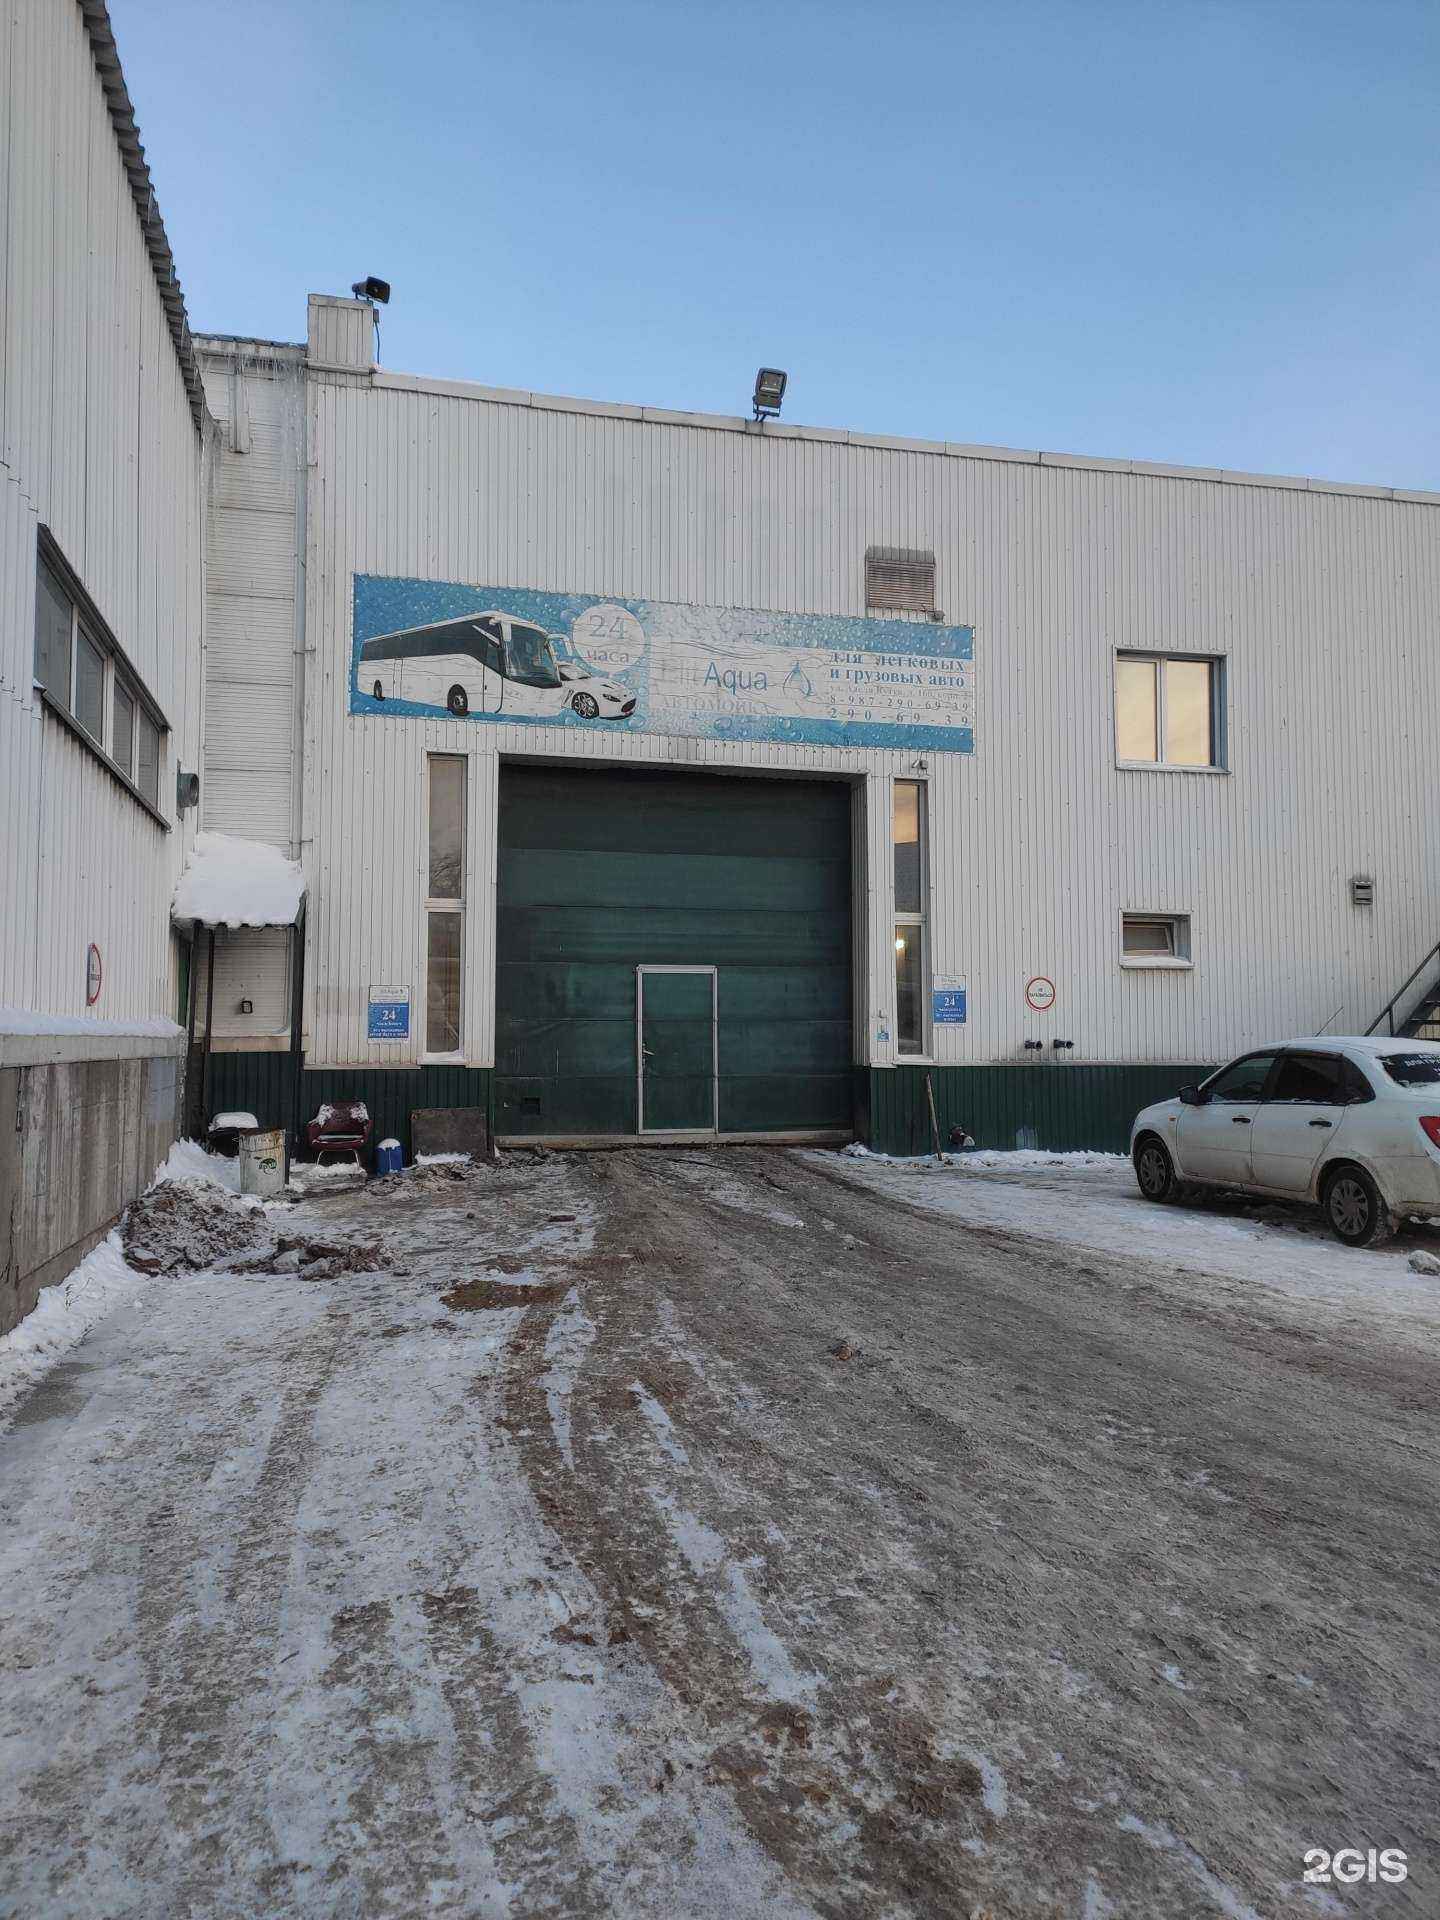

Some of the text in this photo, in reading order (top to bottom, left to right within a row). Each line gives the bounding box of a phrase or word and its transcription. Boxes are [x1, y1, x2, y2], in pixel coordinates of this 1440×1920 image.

[589, 614, 627, 640] 24
[829, 651, 965, 672] для легковых
[703, 661, 768, 696] Aqua
[829, 667, 965, 688] и грузовых авто
